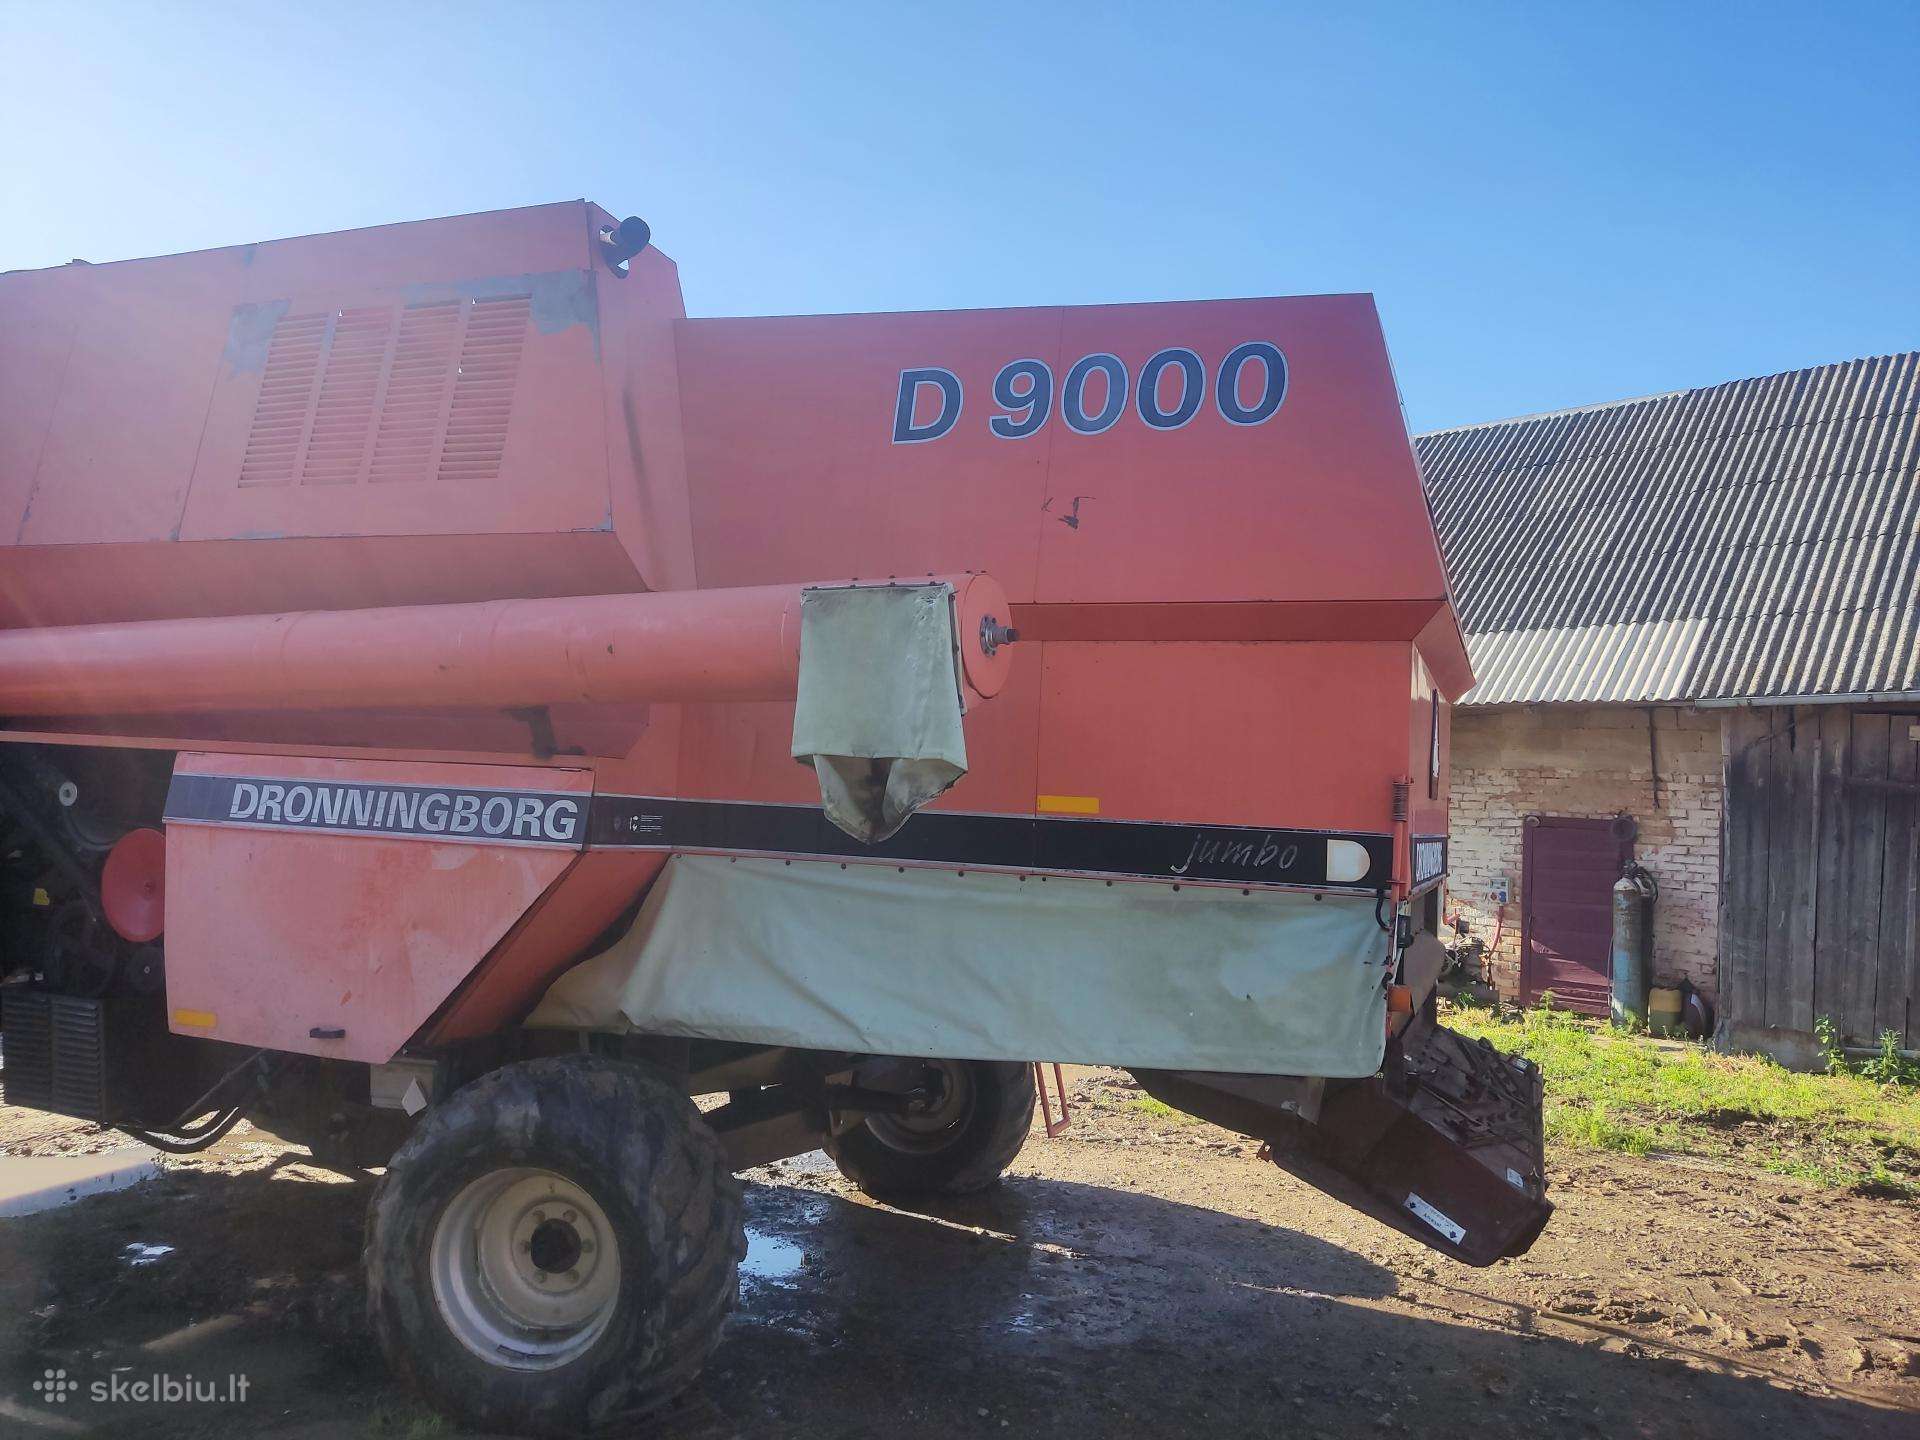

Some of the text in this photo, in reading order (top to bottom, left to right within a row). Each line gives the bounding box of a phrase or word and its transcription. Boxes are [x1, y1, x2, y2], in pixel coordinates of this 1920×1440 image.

[892, 340, 1289, 445] D 9000
[229, 783, 578, 840] DRONNINGBORG
[1169, 834, 1298, 873] jumbo
